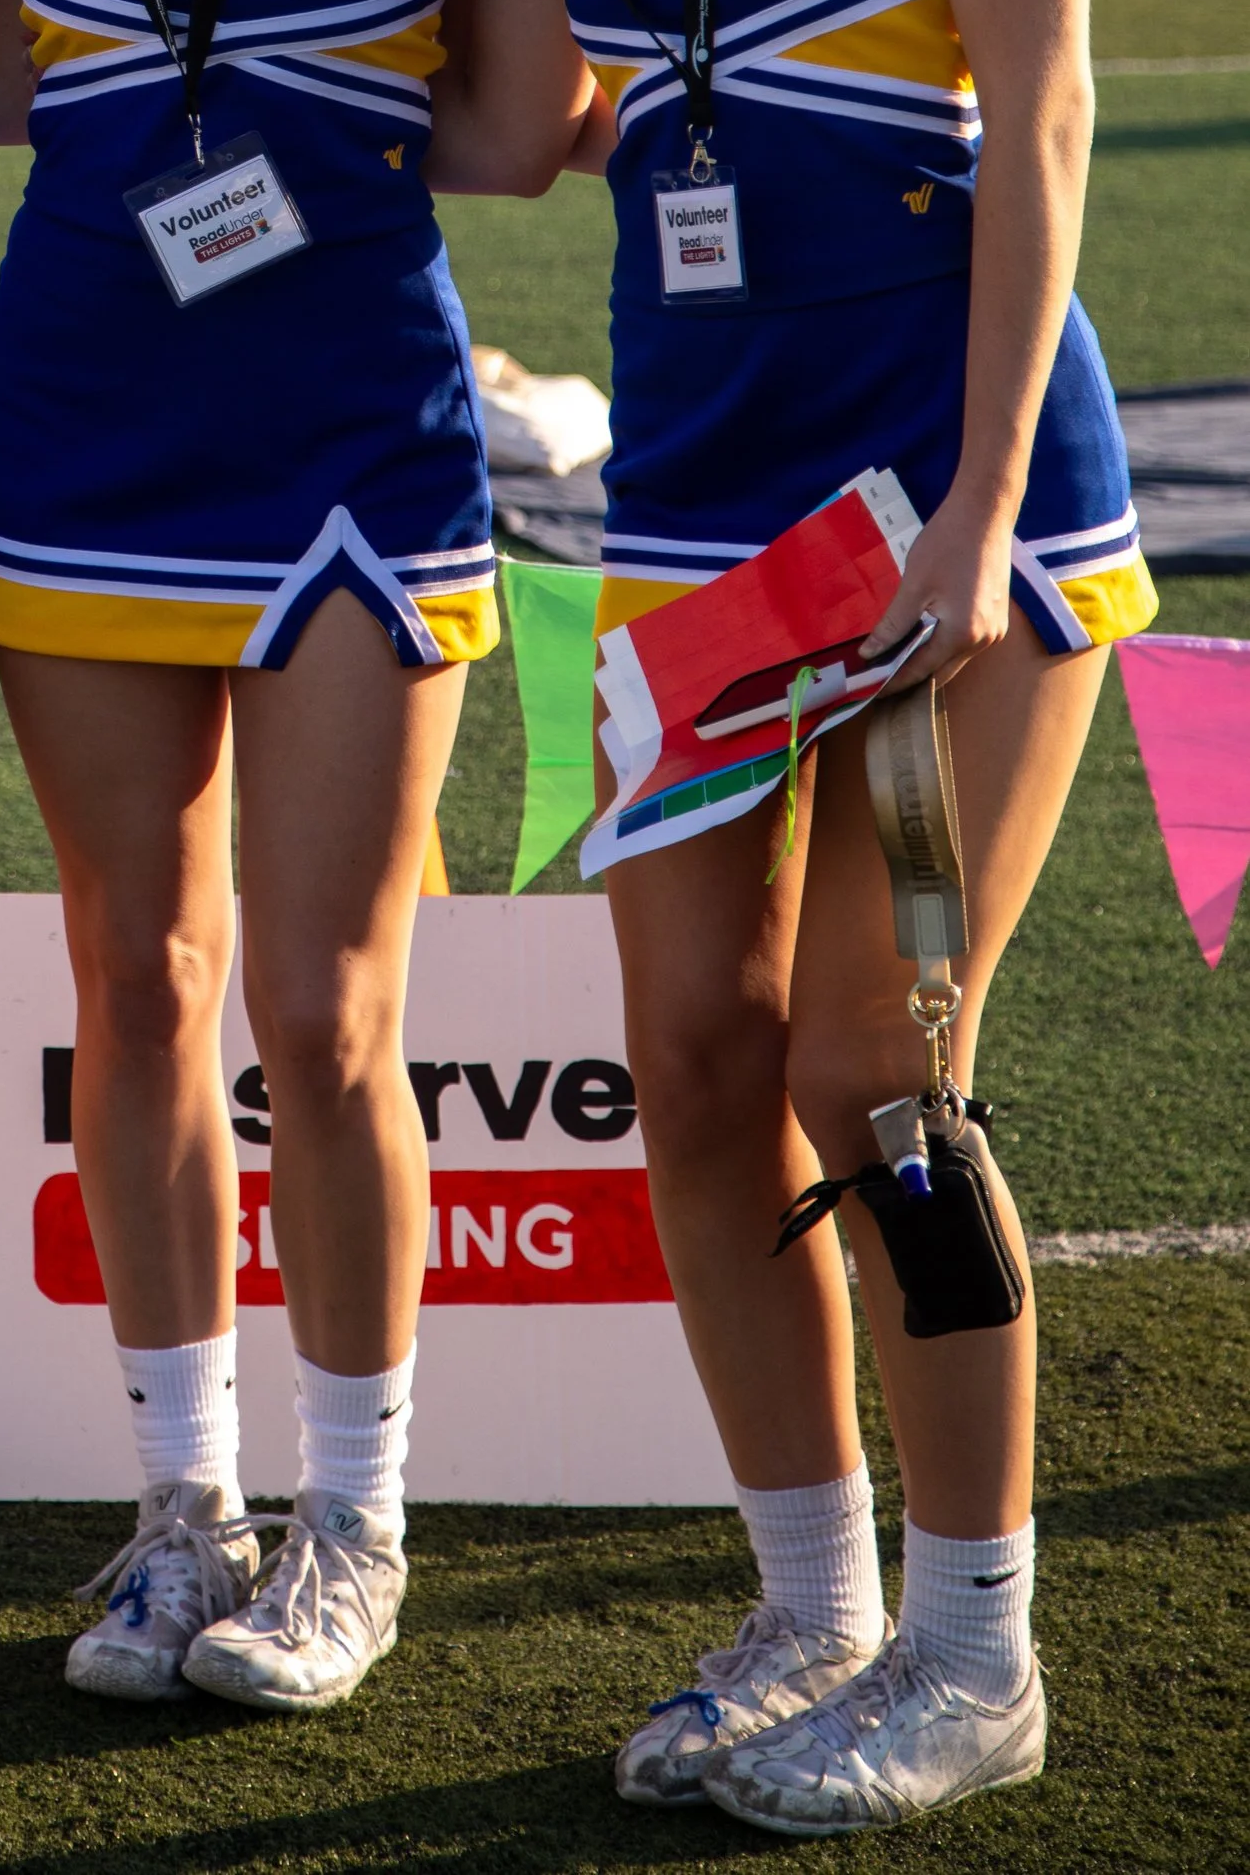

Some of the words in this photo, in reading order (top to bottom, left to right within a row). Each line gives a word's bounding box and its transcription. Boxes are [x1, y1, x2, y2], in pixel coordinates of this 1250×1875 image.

[159, 179, 266, 237] Volunteer
[665, 206, 728, 228] Volunteer
[188, 208, 265, 250] ReadUnder
[200, 246, 219, 258] THE
[220, 230, 252, 250] LIGHTS
[683, 253, 694, 261] THE
[695, 251, 715, 260] LIGHTS
